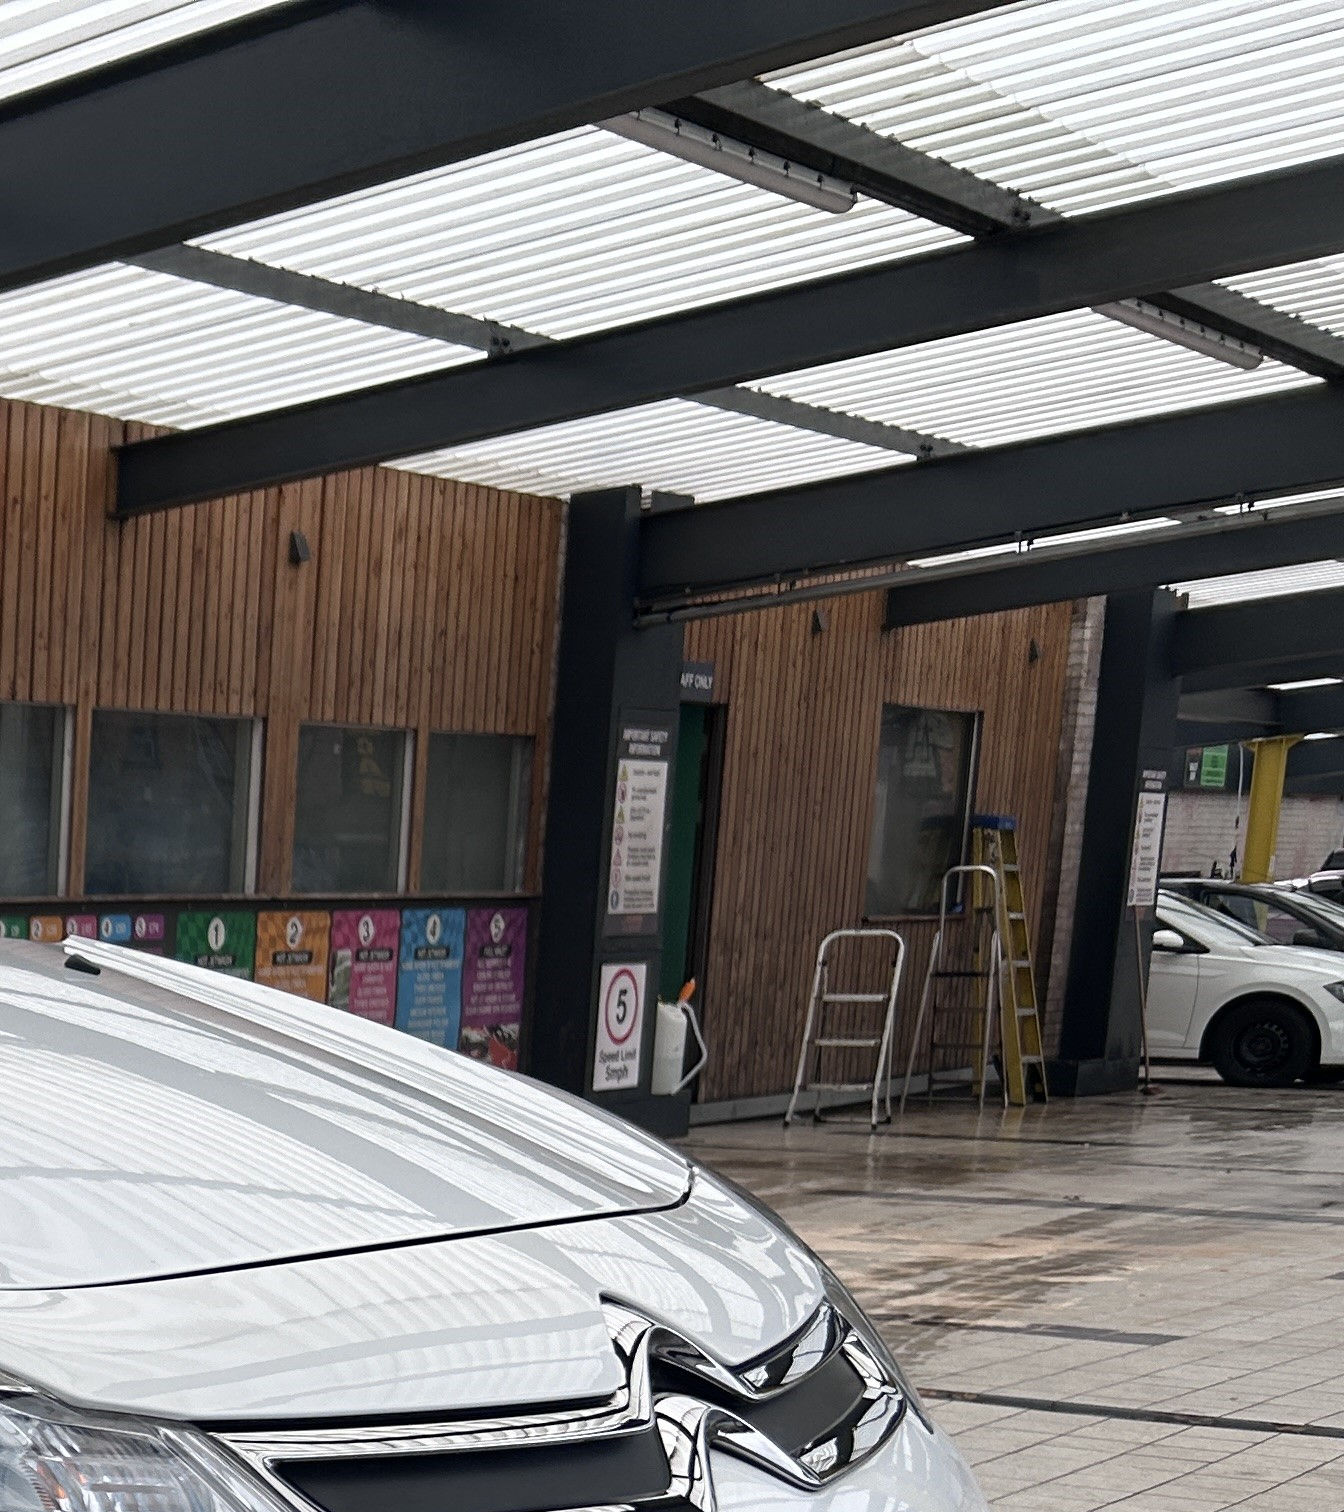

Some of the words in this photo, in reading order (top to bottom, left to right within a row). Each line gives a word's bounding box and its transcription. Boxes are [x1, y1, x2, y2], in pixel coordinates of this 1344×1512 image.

[289, 920, 299, 944] 2
[362, 920, 371, 942] 3
[615, 988, 628, 1025] 5
